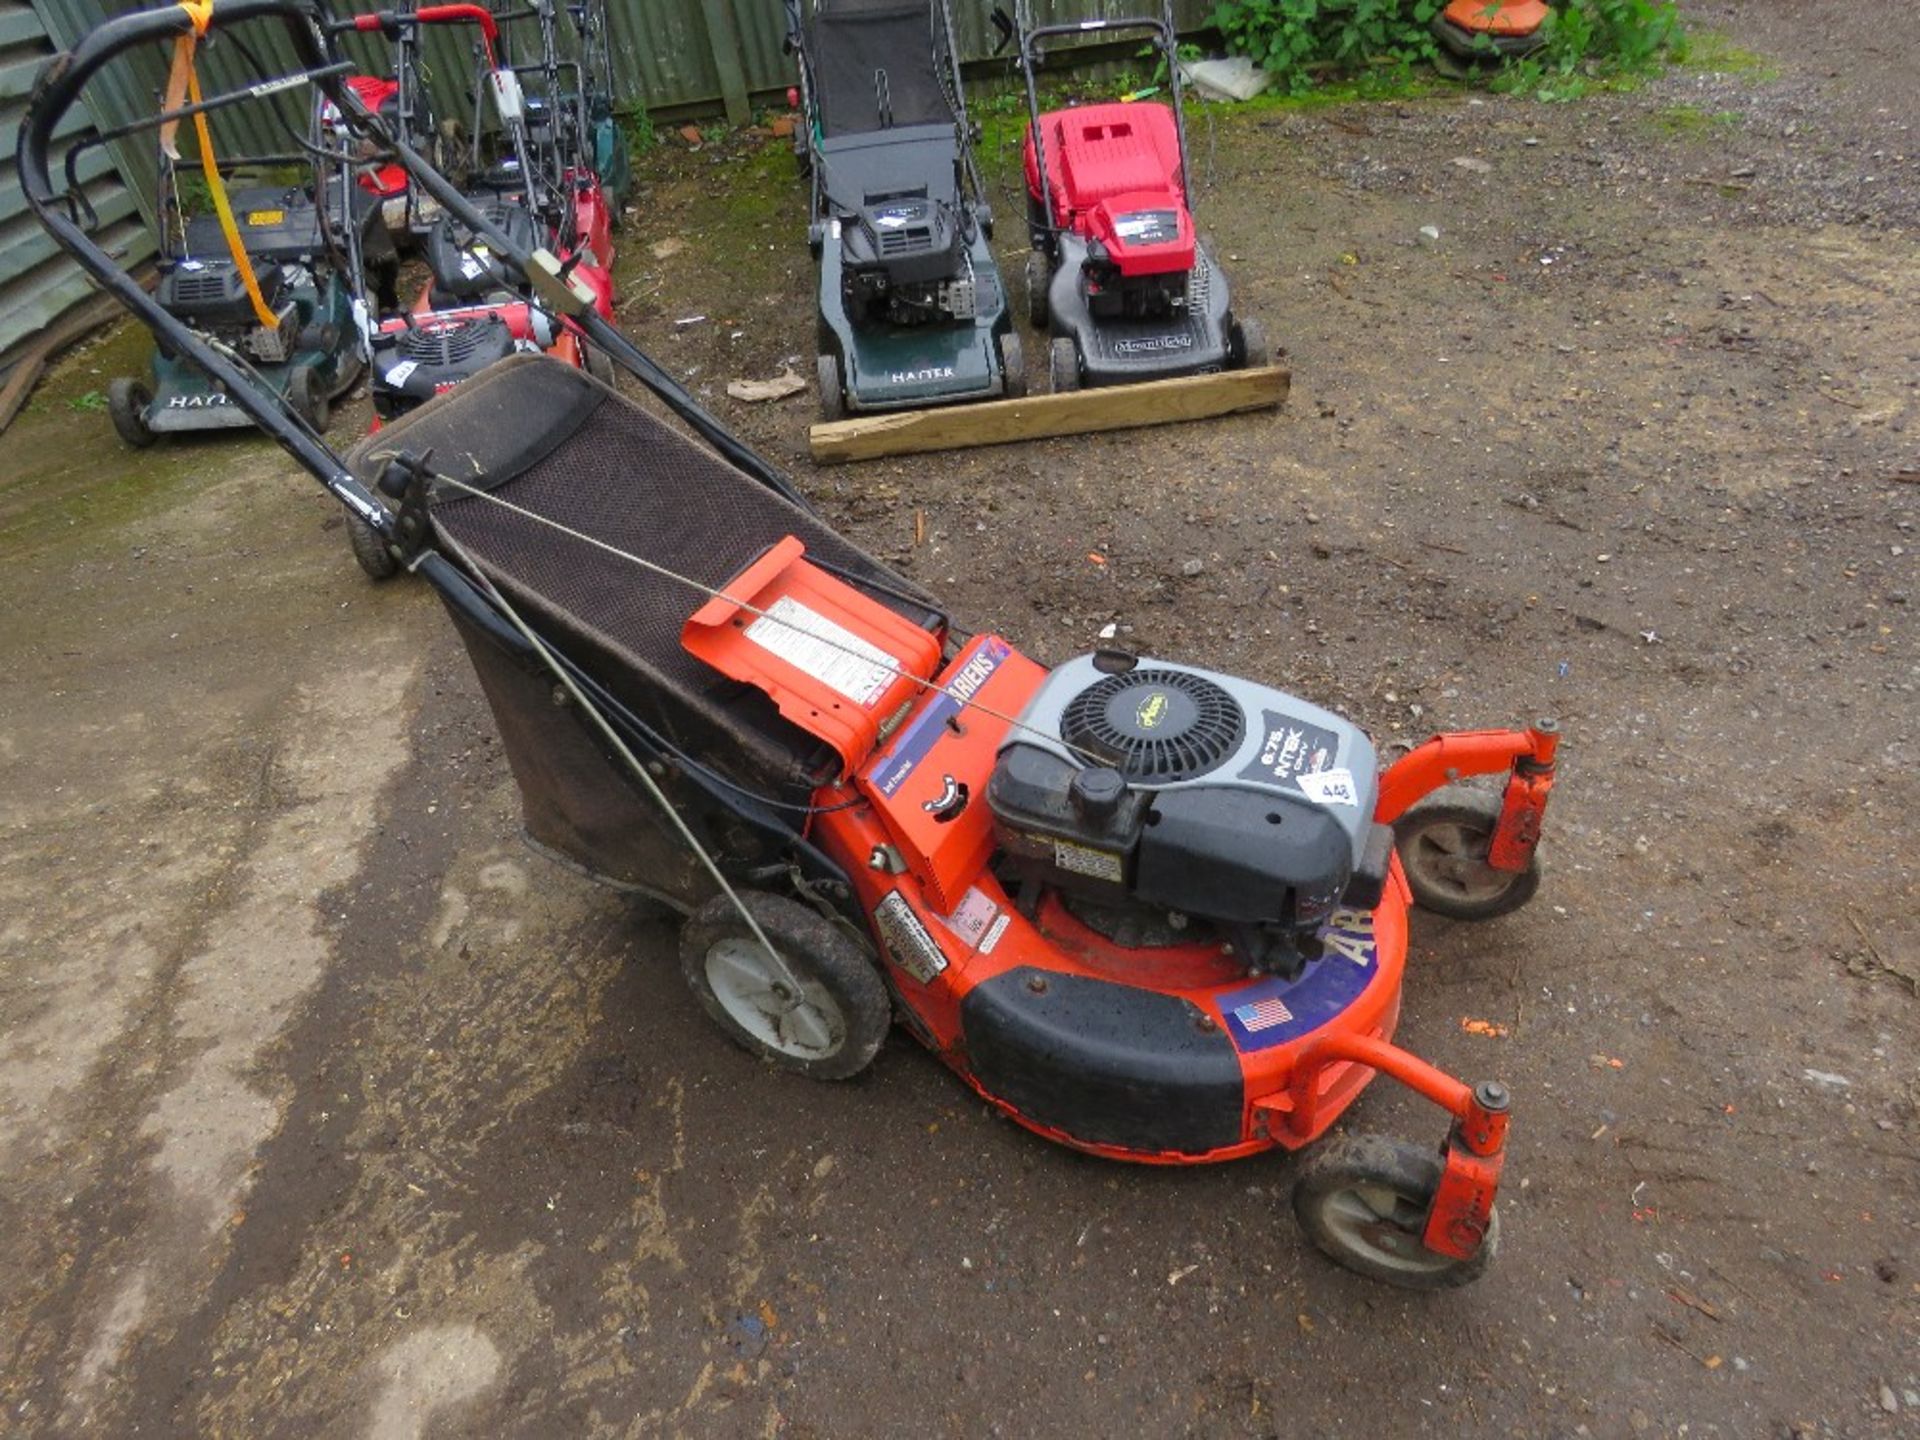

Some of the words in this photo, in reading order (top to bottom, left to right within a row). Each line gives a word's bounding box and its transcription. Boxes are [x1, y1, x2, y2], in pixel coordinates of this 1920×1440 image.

[947, 652, 994, 707] ARIENS
[1273, 727, 1304, 778] INTEK
[1324, 909, 1376, 967] AR
